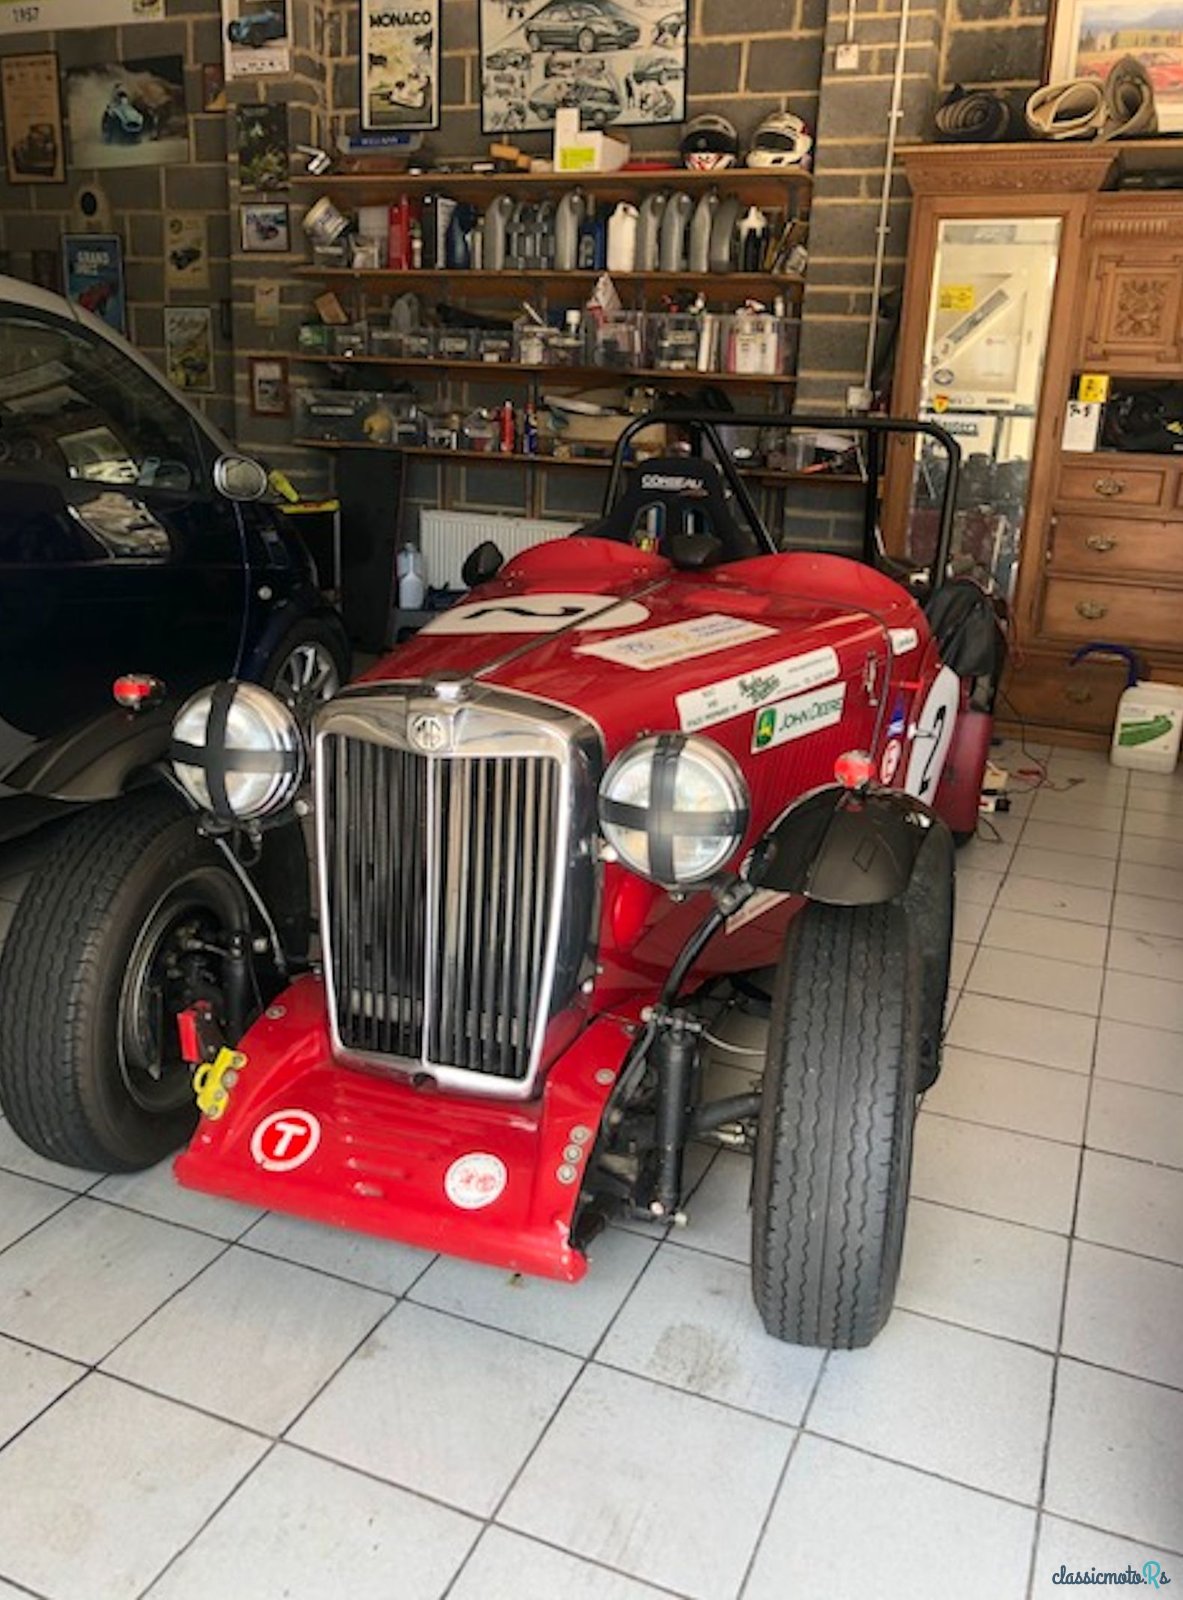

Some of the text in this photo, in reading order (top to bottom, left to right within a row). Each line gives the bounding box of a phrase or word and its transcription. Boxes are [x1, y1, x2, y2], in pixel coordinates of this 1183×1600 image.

[369, 11, 432, 28] MONACO
[641, 473, 704, 493] CORBEAU
[779, 710, 808, 732] JOHN
[918, 704, 947, 797] 2
[272, 1121, 308, 1158] T
